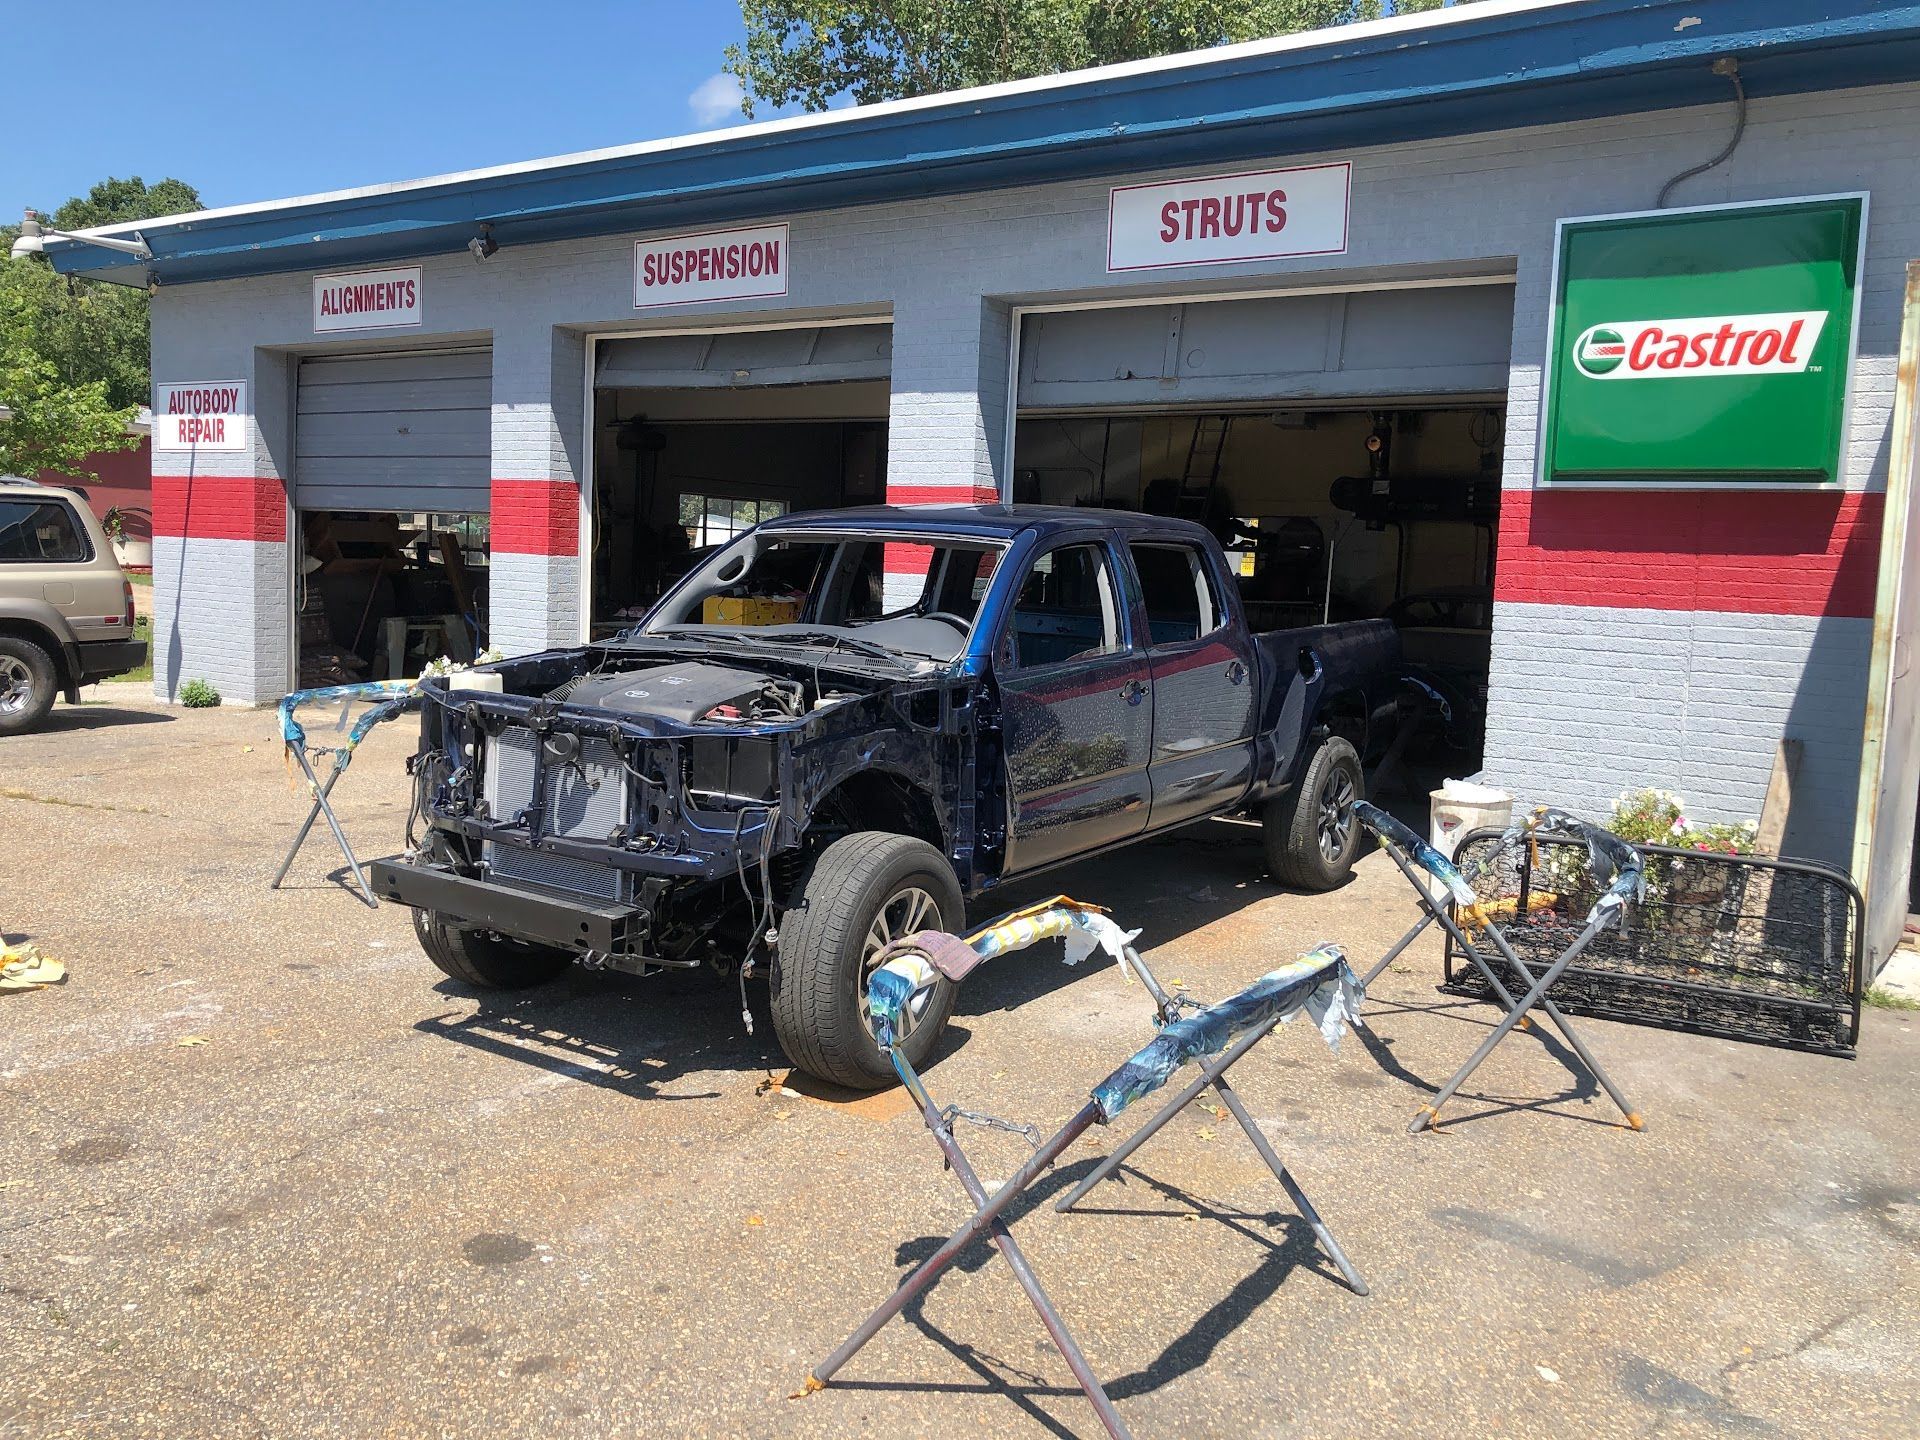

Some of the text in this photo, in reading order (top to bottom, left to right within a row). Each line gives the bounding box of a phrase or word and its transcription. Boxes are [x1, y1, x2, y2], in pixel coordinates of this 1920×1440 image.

[1160, 189, 1287, 243] STRUTS
[643, 241, 780, 286] SUSPENSION
[321, 280, 416, 316] ALIGNMENTS
[1628, 319, 1805, 371] Castrol
[169, 388, 239, 414] AUTOBODY
[178, 418, 225, 443] REPAIR
